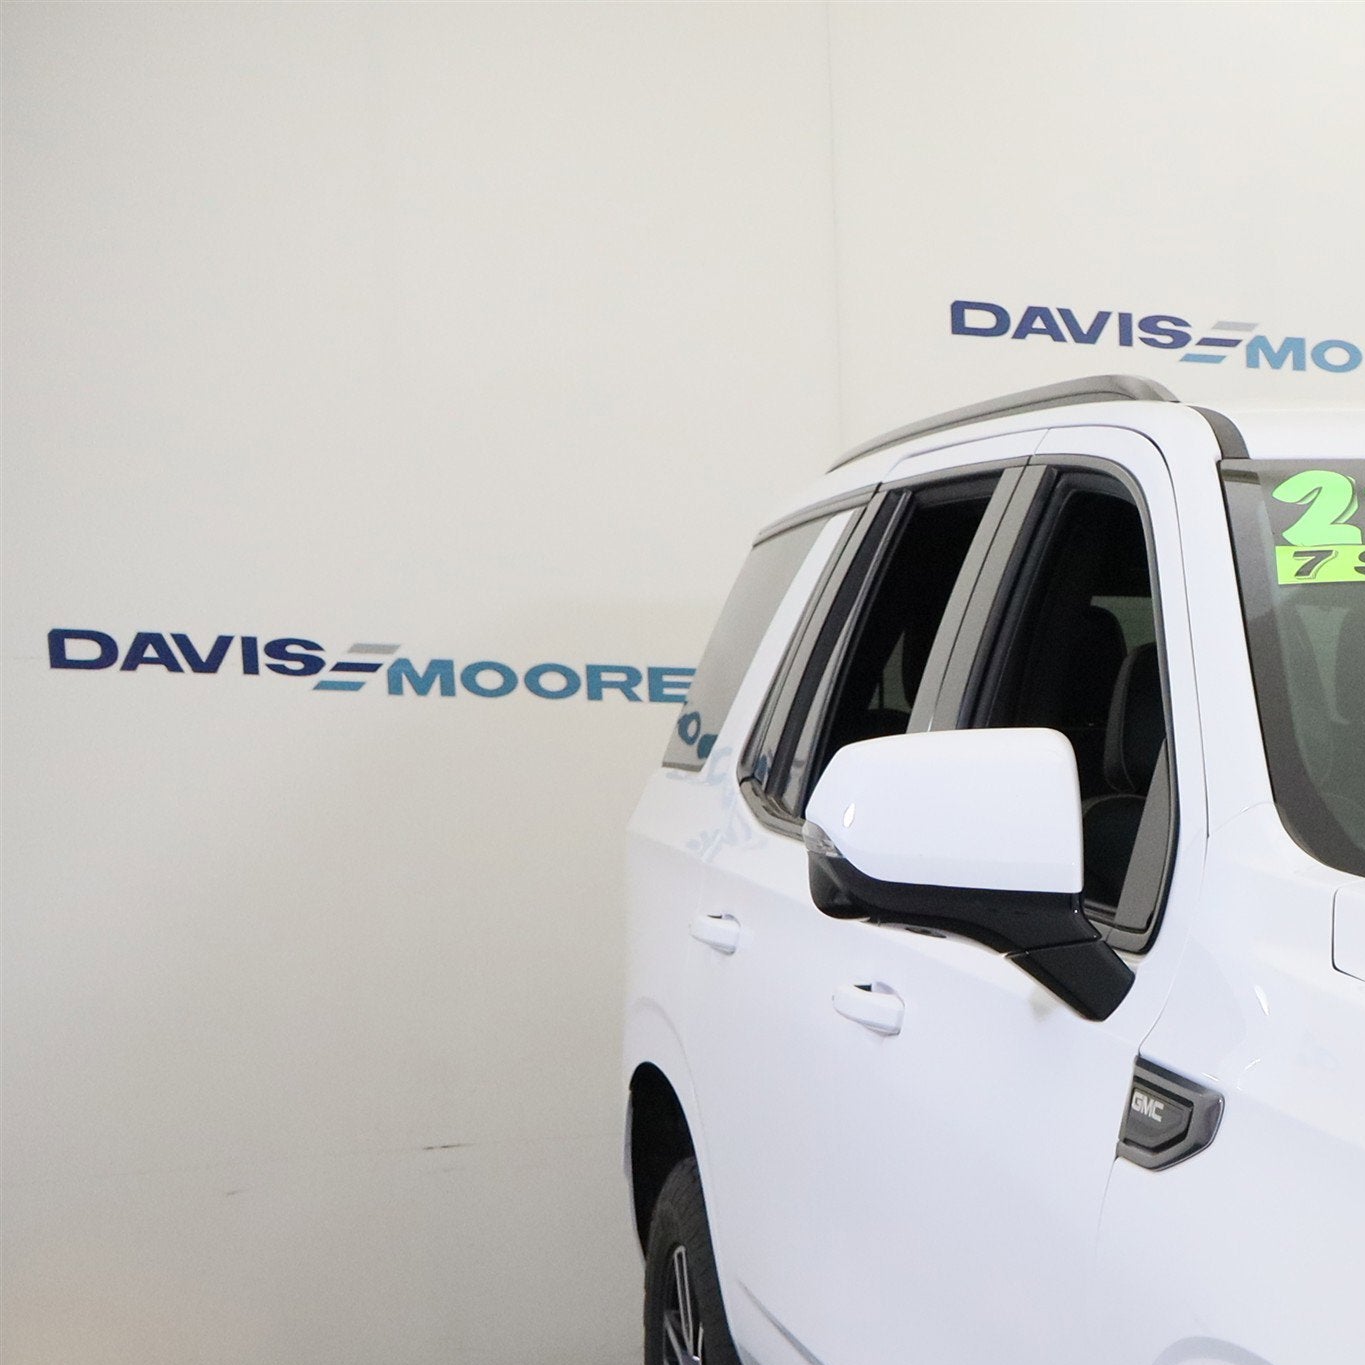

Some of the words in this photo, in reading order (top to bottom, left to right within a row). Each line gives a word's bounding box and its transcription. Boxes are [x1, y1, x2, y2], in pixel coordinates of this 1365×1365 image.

[949, 299, 1192, 349] DAVIS
[1293, 549, 1338, 579] 7
[48, 626, 326, 676] DAVIS
[387, 657, 698, 704] MOORE
[1131, 1090, 1165, 1122] GMC
